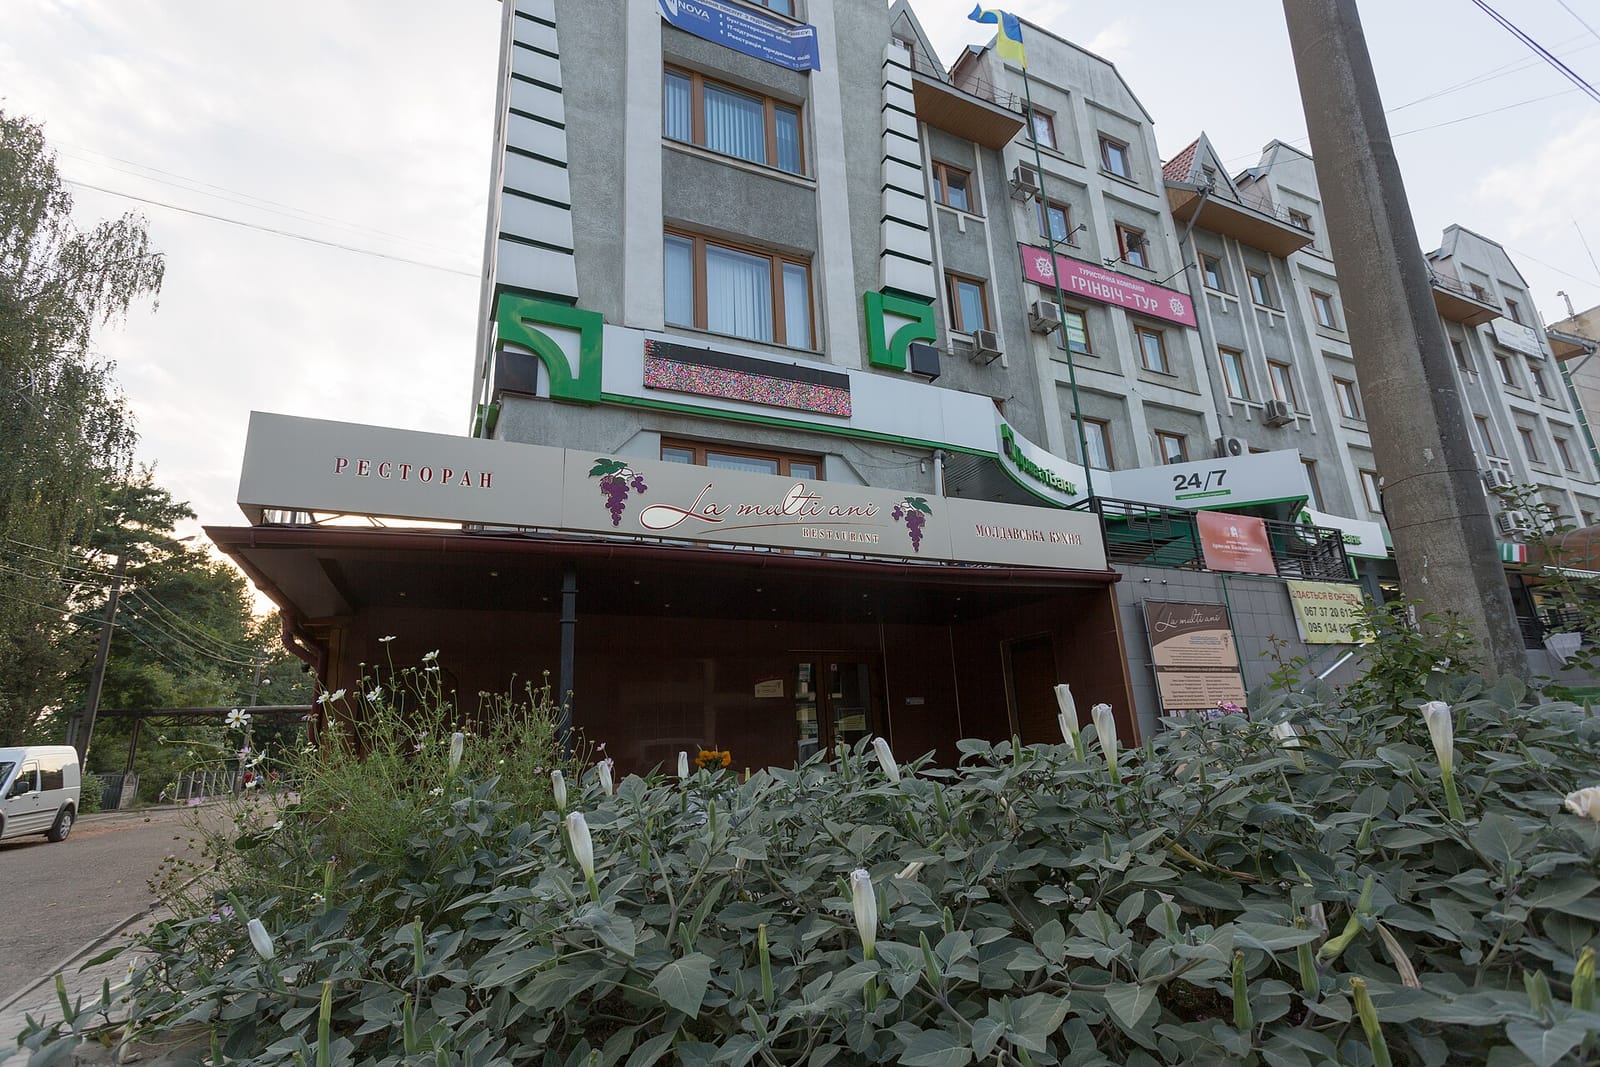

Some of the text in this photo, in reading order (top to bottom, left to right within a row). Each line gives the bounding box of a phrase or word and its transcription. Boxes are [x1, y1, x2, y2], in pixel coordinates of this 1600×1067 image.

[678, 1, 710, 19] NOVA
[335, 457, 492, 489] РЕСТОРАН
[1173, 469, 1227, 492] 24/7
[639, 483, 730, 530] La
[828, 500, 880, 517] ani
[802, 527, 880, 544] RESTAURANT
[975, 524, 1082, 545] МОЛДАВСЬКА КУХНЯ
[1304, 606, 1317, 617] 067
[1319, 607, 1328, 617] 37
[1330, 607, 1339, 617] 20
[1308, 622, 1323, 633] 095
[1324, 623, 1337, 633] 134
